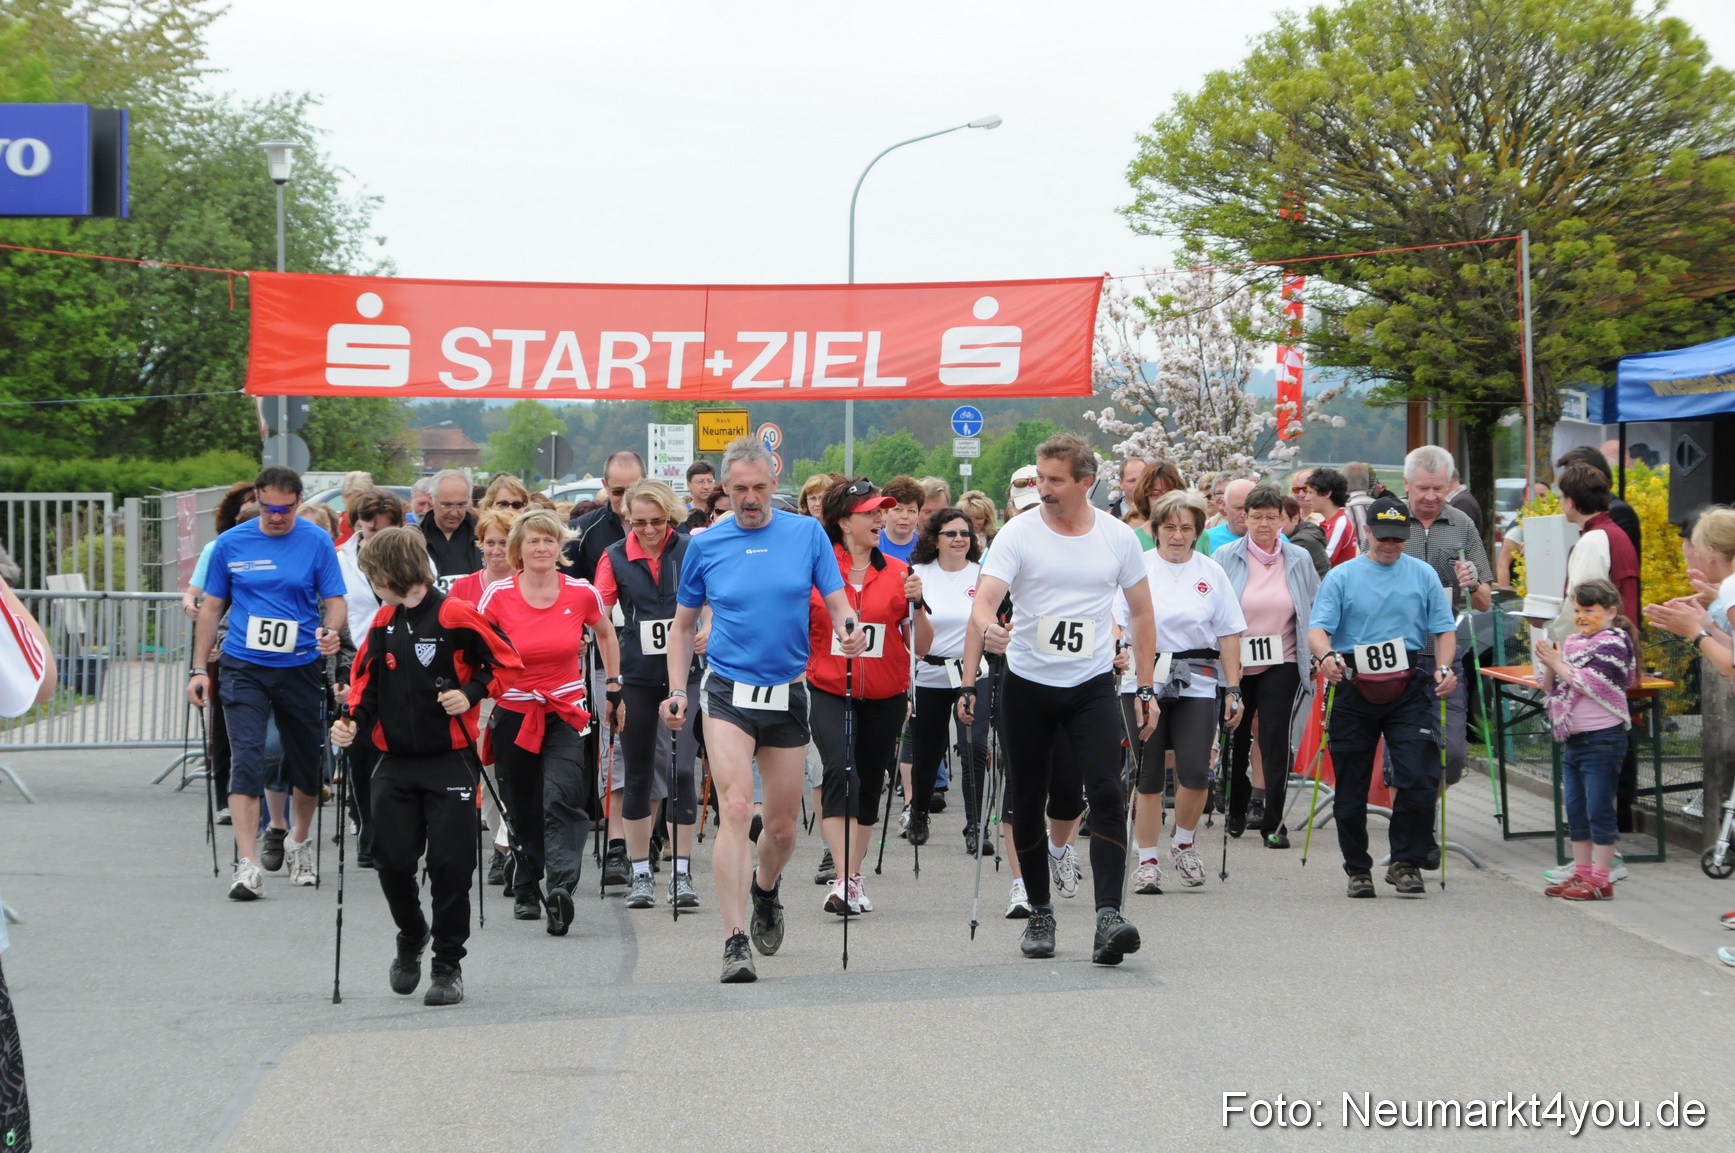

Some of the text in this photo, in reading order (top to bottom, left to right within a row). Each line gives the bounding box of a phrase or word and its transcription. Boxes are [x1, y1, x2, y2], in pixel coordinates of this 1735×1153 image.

[702, 425, 745, 437] Neumarkt
[762, 430, 776, 443] 60
[258, 620, 288, 648] 50
[652, 621, 674, 650] 9
[1049, 620, 1084, 653] 45
[1249, 637, 1272, 661] 111
[1366, 642, 1398, 671] 89
